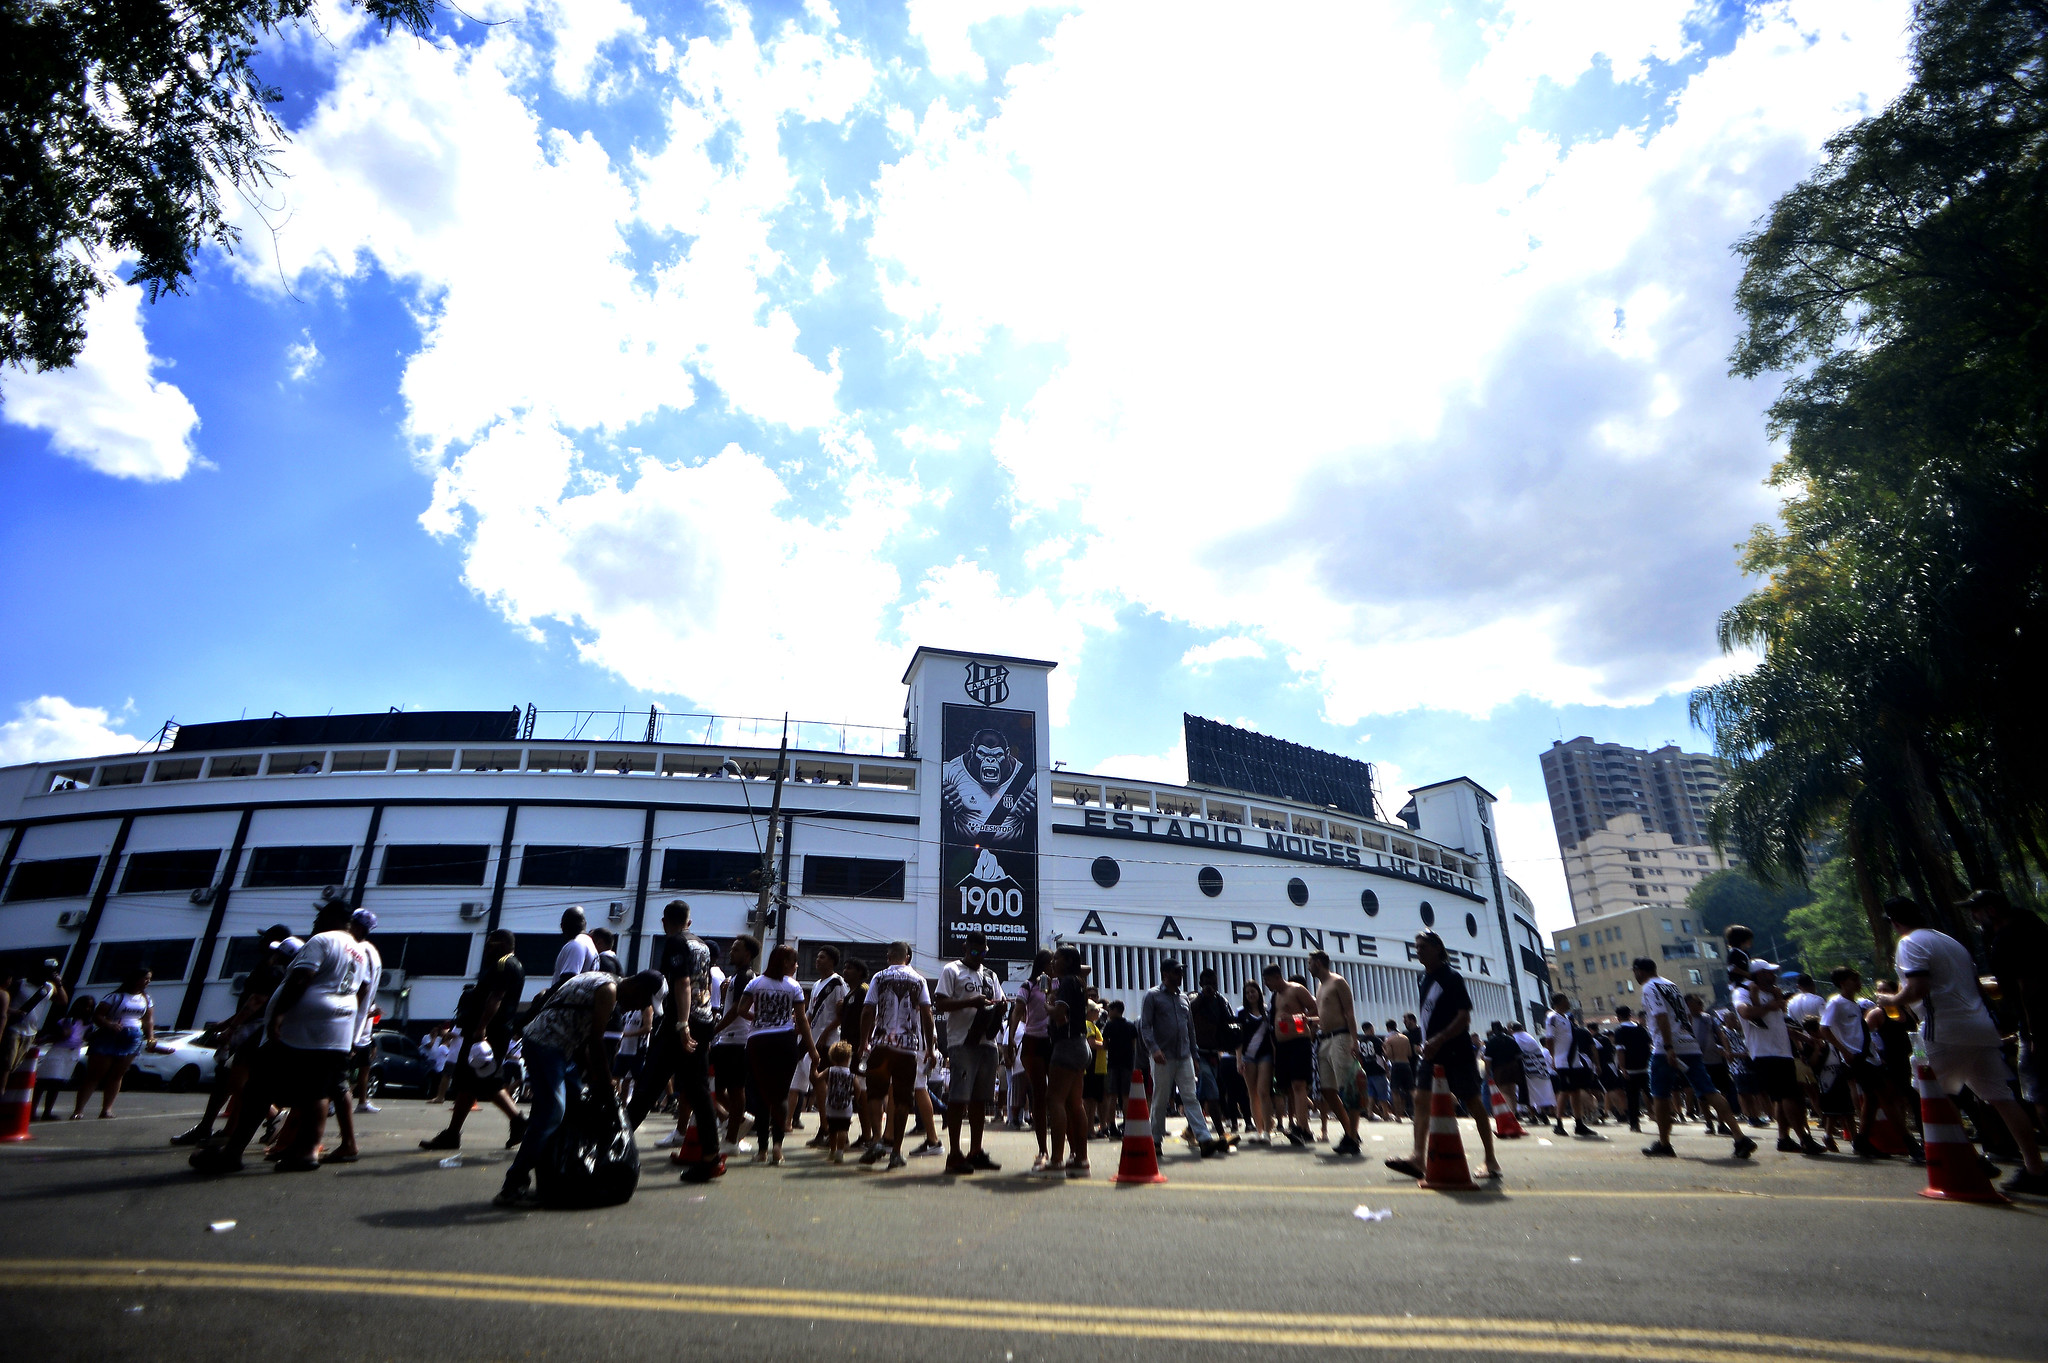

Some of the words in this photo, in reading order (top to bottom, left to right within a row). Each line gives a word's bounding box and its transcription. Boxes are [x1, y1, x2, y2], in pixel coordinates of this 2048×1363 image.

[1085, 808, 1242, 846] ESTADIO
[1265, 832, 1361, 867] MOISES
[960, 886, 1023, 917] 1900
[1079, 909, 1118, 937] A.
[1157, 915, 1193, 942] A.
[1231, 920, 1378, 958] PONTE
[1405, 941, 1491, 977] PETA
